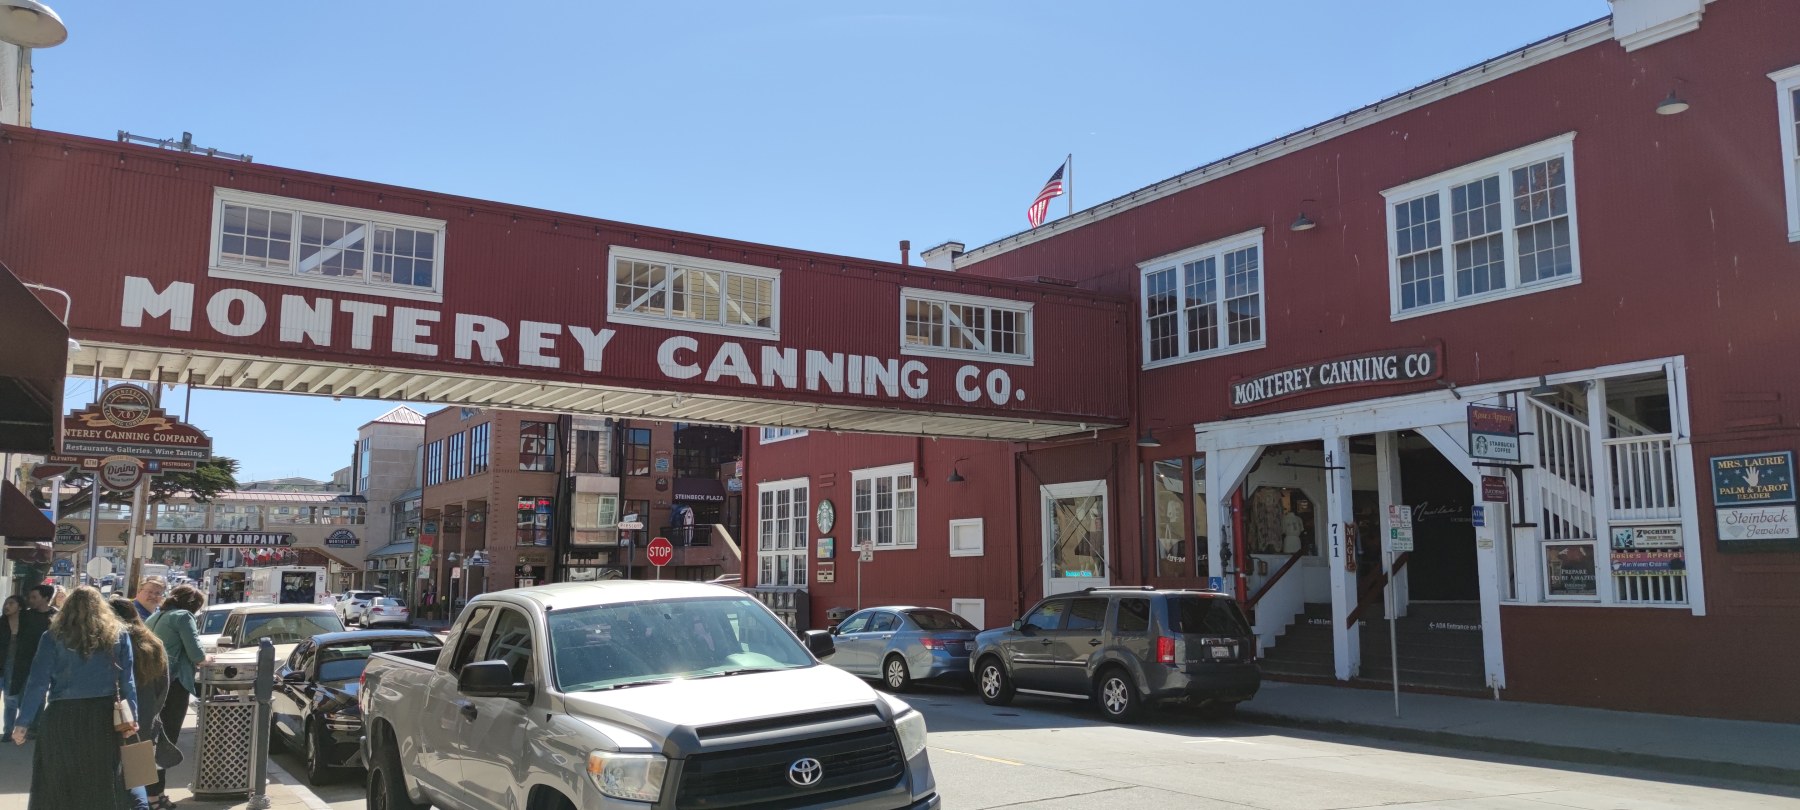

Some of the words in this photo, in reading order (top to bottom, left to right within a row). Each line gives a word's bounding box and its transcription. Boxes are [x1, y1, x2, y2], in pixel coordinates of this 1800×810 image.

[120, 275, 617, 373] MONTEREY
[656, 335, 929, 400] CANNING
[955, 364, 1026, 406] CO.
[1233, 366, 1314, 405] MONTEREY
[1319, 355, 1398, 386] CANNING
[1404, 352, 1431, 378] CO
[63, 428, 102, 438] NTEREY
[104, 429, 150, 441] CANNING
[153, 432, 199, 444] COMPANY
[1489, 440, 1516, 449] STARBUCKS
[154, 447, 175, 455] Wine
[175, 449, 205, 457] Tasting.
[106, 463, 137, 475] Dining
[1717, 459, 1743, 469] MRS.
[1744, 455, 1785, 467] LAURIE
[1719, 486, 1745, 495] PALM
[1746, 485, 1754, 493] &
[1756, 483, 1789, 493] TAROT
[1737, 492, 1771, 500] READER
[1726, 508, 1788, 525] Steinbeck
[1746, 524, 1790, 538] Jewelers
[153, 533, 191, 543] NNERY
[197, 533, 222, 543] ROW
[228, 535, 283, 545] COMPANY
[1331, 523, 1340, 558] 711
[649, 546, 671, 557] STOP
[1346, 527, 1354, 569] MAGIC
